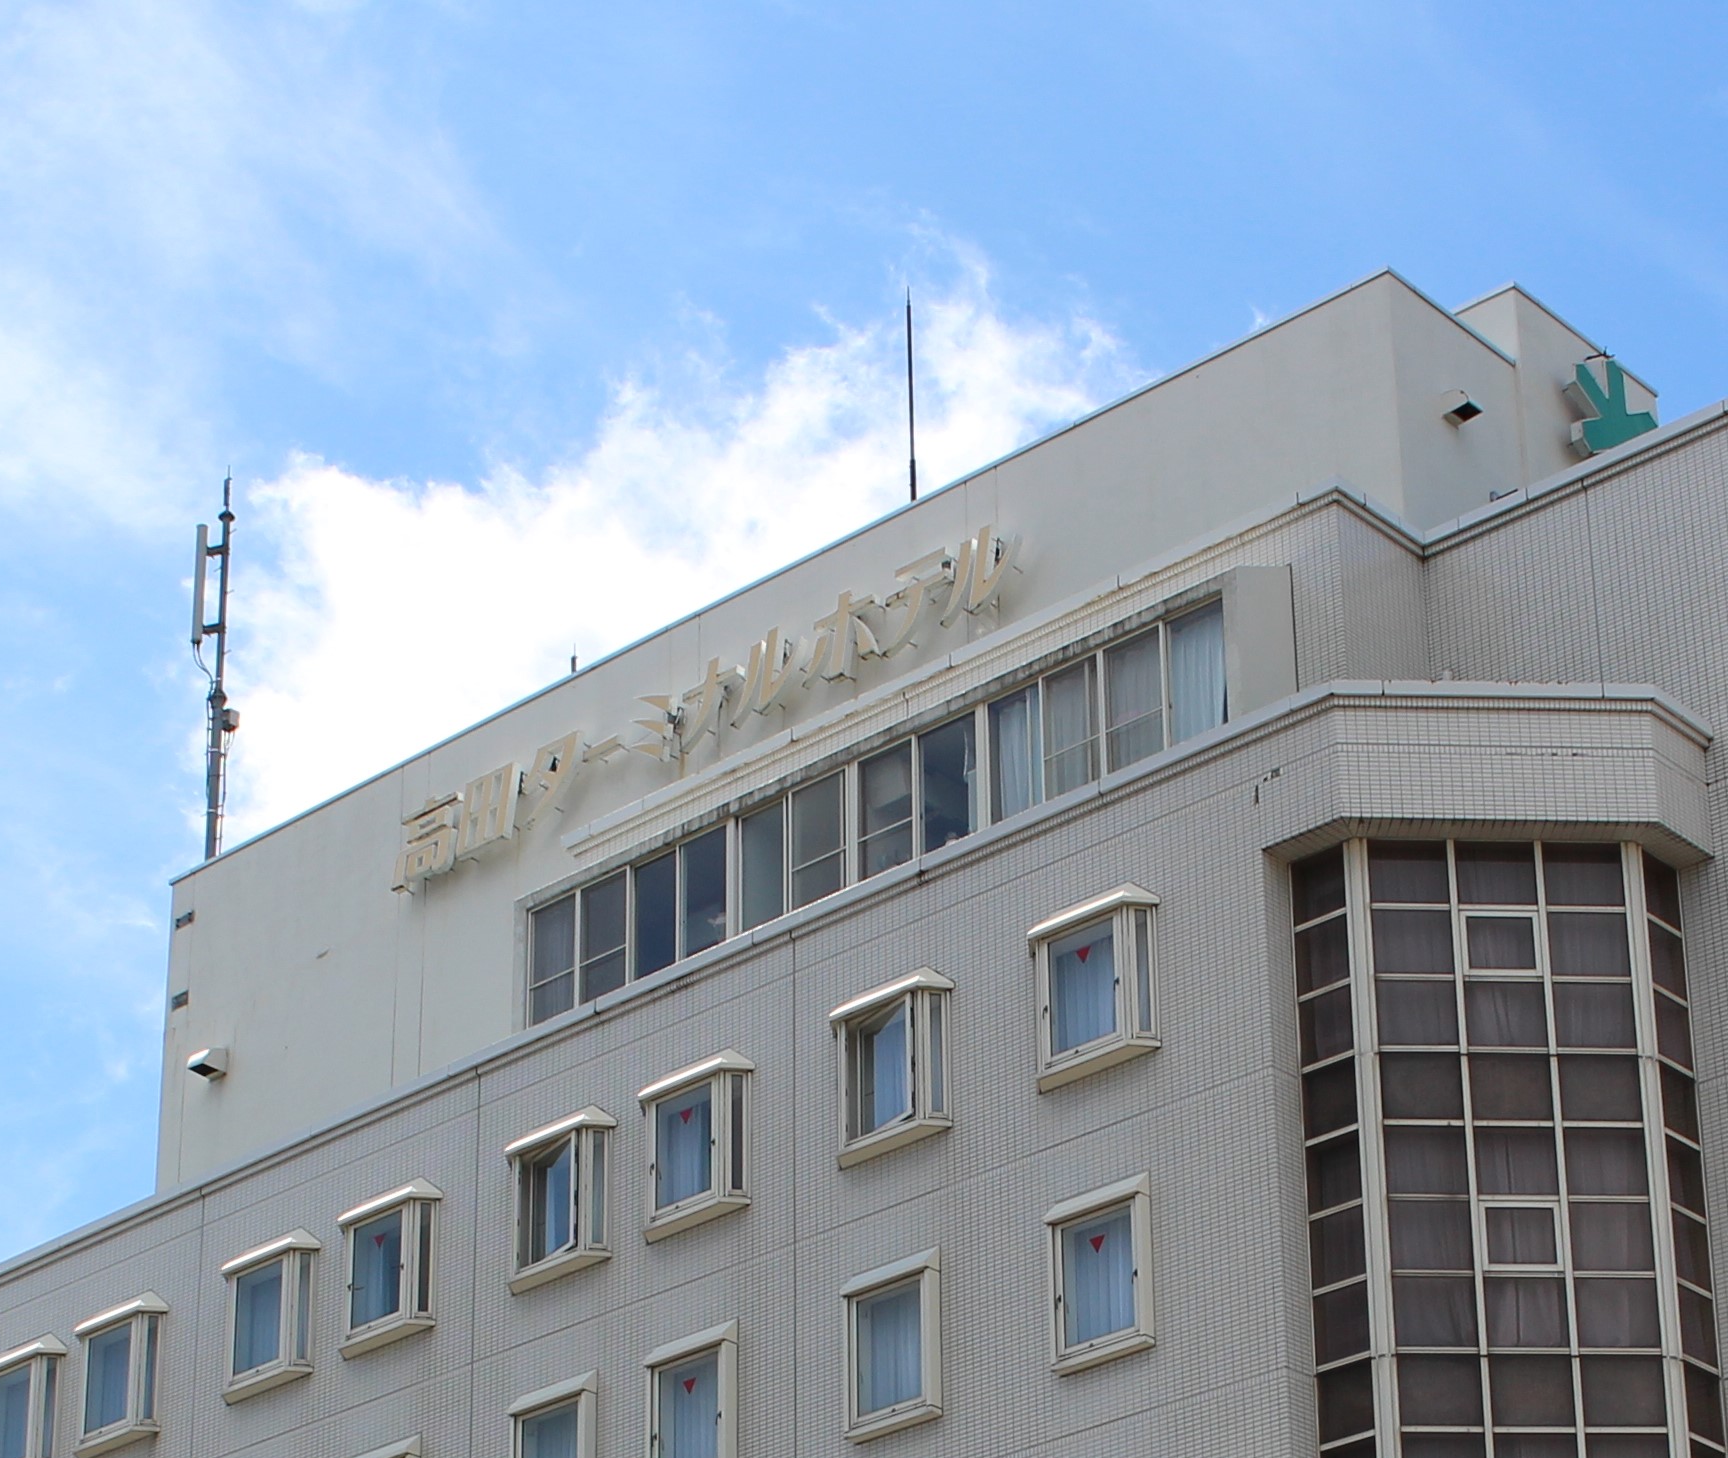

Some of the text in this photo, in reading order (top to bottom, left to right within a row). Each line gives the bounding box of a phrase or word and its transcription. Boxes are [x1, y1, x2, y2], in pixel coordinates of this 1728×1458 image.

[390, 524, 1022, 894] 高田ターミナルホテル
